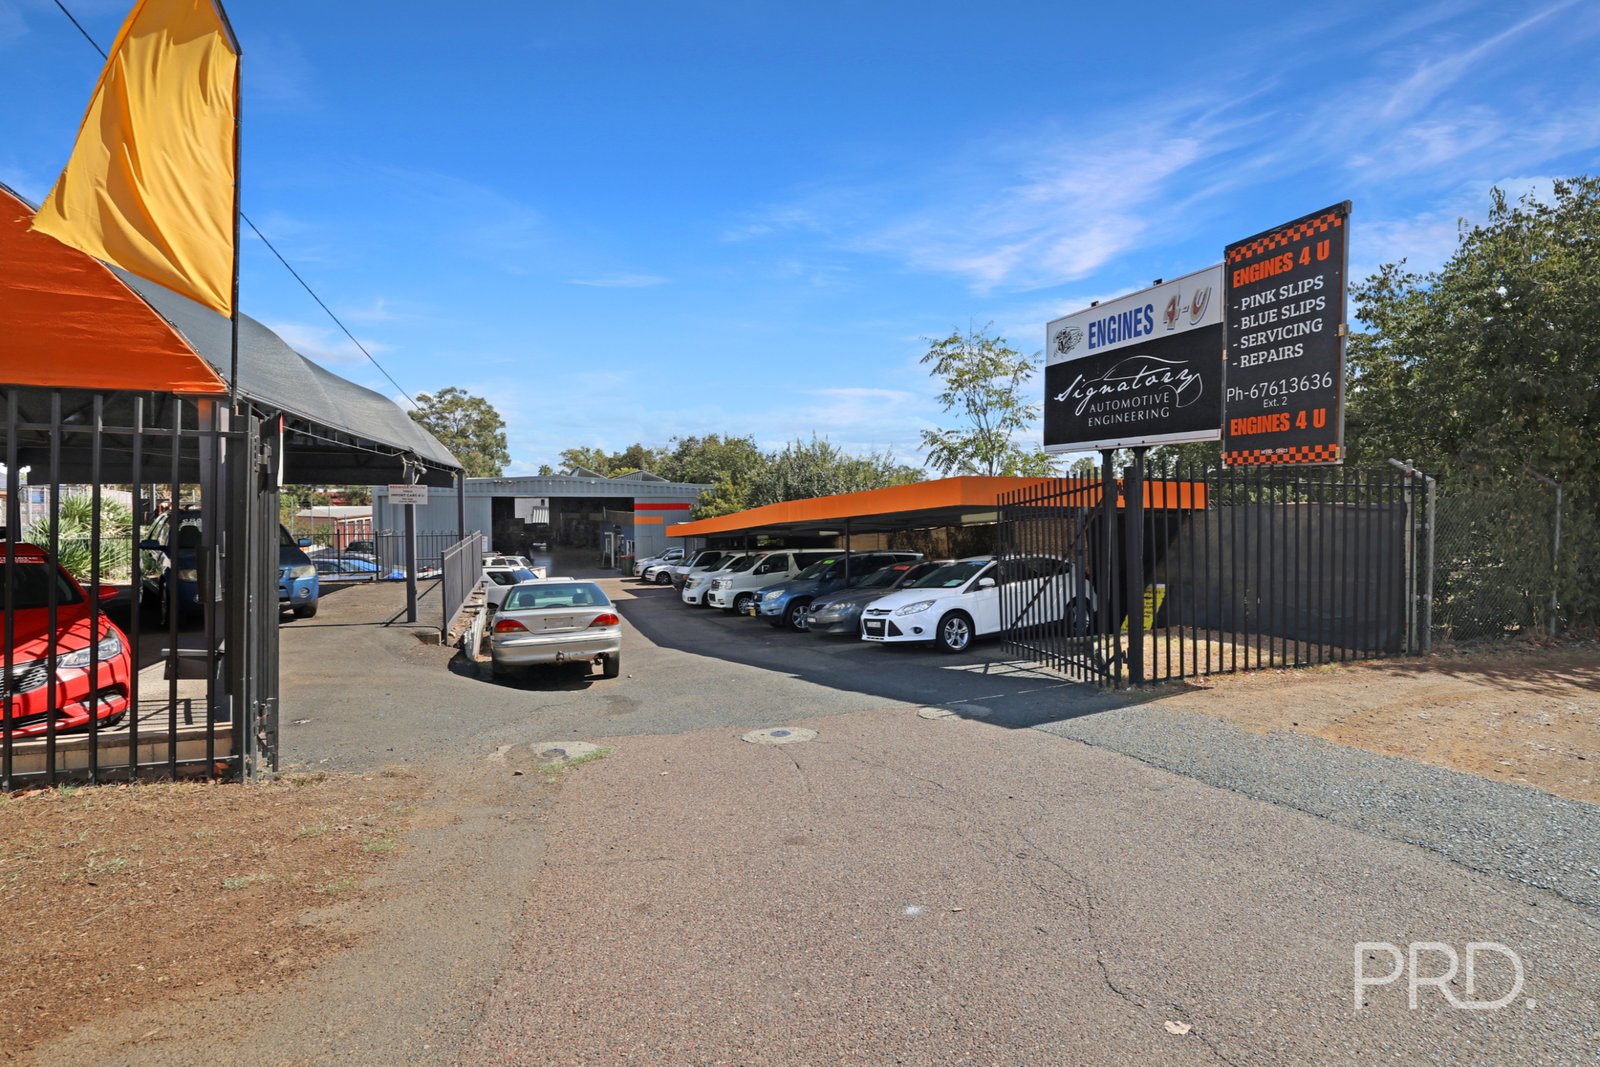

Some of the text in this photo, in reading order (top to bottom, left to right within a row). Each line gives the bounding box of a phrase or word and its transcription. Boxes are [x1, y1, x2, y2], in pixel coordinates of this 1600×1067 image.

[1232, 239, 1330, 289] ENGINES 4 U
[1241, 289, 1276, 311] PINK
[1279, 275, 1324, 300] SLIPS
[1088, 303, 1154, 350] ENGINES
[1240, 309, 1278, 330] BLUE
[1281, 296, 1326, 320] SLIPS
[1240, 318, 1323, 349] SERVICING
[1240, 343, 1304, 368] REPAIRS
[1053, 365, 1203, 416] Signatory
[1226, 371, 1333, 402] Ph-67613636
[1263, 396, 1288, 408] Ext. 2
[1088, 407, 1170, 427] ENGINEERING
[1089, 391, 1170, 414] AUTOMOTIVE
[1230, 407, 1326, 437] ENGINES 4 U
